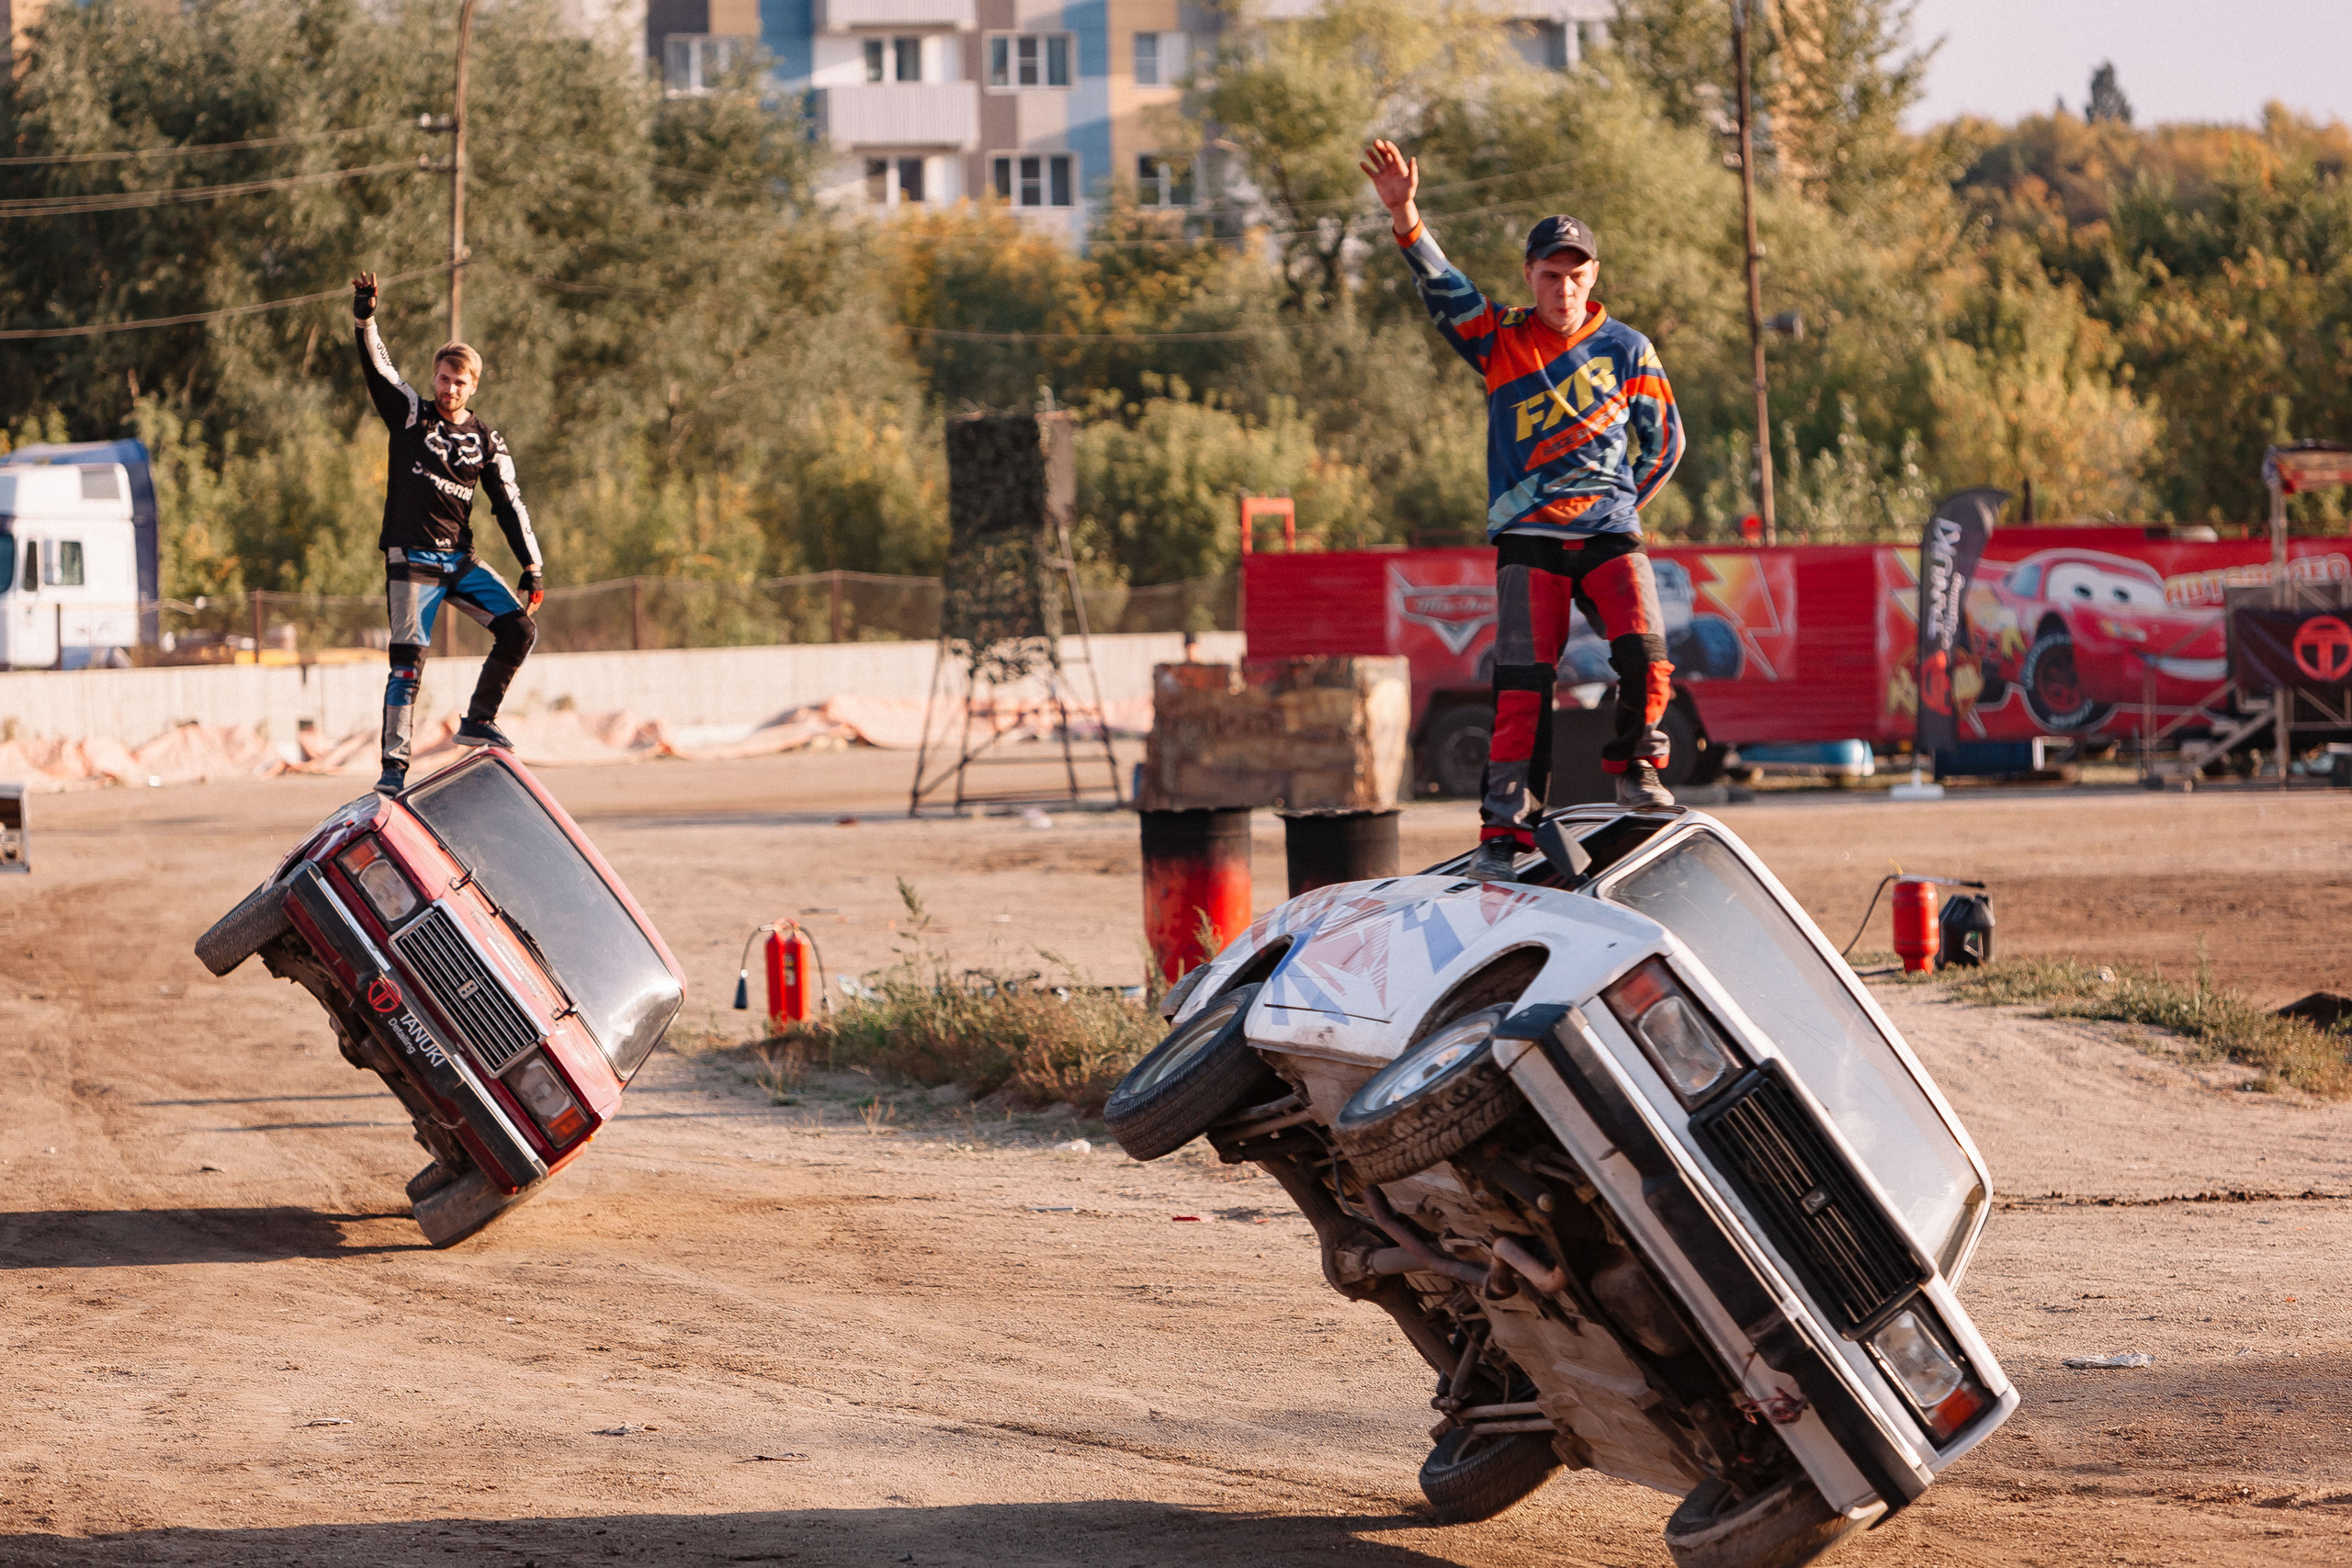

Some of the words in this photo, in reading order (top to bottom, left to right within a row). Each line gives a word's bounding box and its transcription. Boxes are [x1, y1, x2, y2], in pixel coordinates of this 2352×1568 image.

[1510, 356, 1617, 442] FXR
[388, 1017, 416, 1055] Detailing
[399, 1009, 447, 1067] TANUKI
